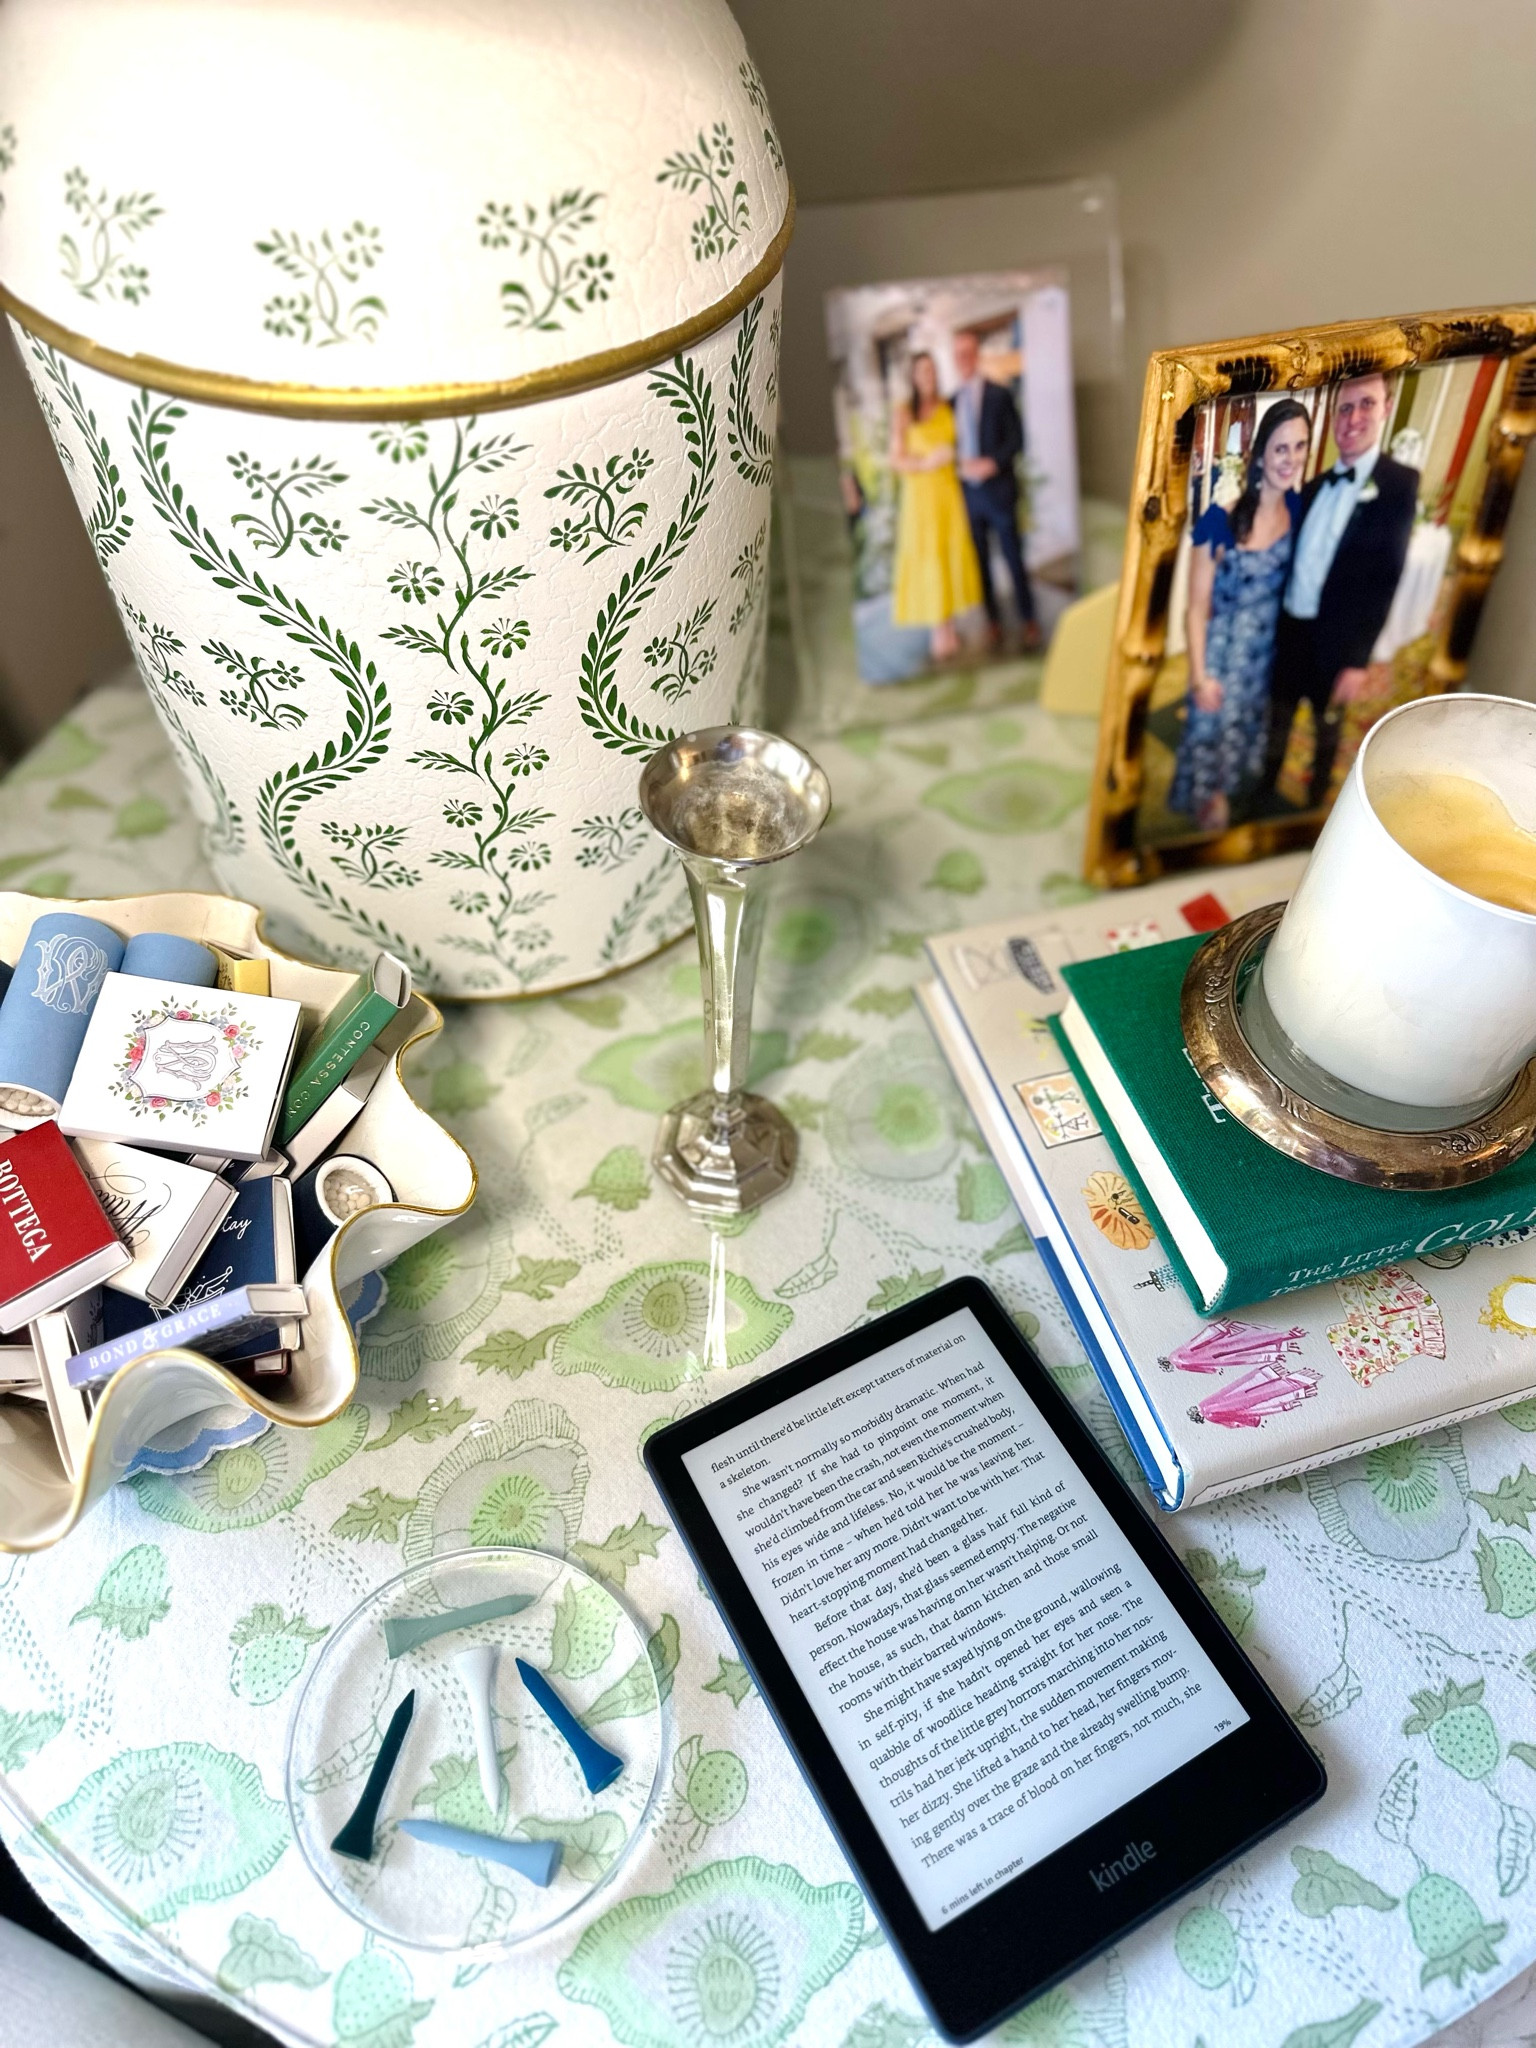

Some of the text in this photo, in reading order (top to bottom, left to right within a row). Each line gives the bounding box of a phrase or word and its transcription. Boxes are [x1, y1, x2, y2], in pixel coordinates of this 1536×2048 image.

[285, 1021, 371, 1119] CONTESSA.COM
[0, 1158, 52, 1263] BOTTEGA
[1288, 1239, 1413, 1283] THE LITTLE
[88, 1303, 223, 1370] BOND & GRACE
[710, 1334, 967, 1474] flesh until there'd be little left except tatters of material on
[719, 1458, 772, 1490] a skeleton.
[736, 1376, 996, 1522] she changed? If she had to pinpoint one moment, it
[741, 1360, 986, 1498] She wasn't normally so morbidly dramatic. When had
[788, 1506, 989, 1625] heart-stopping moment had changed her.
[808, 1498, 1078, 1663] person. Nowadays, that glass seemed empty. The negative
[828, 1528, 1100, 1695] the house, as such, that damn kitchen and those small
[838, 1610, 1007, 1714] rooms with their barred windows.
[857, 1579, 1133, 1752] in self-pity, if she hadn't opened her eyes and seen a
[863, 1562, 1123, 1724] She might have stayed lying on the ground, wallowing
[869, 1596, 1144, 1772] quabble of woodlice heading straight for her nose. The
[879, 1615, 1154, 1789] thoughts of the little grey horrors marching into her nos-
[889, 1630, 1169, 1809] trils had her jerk upright, the sudden movement making
[910, 1666, 1191, 1849] ing gently over the graze and the already swelling bump.
[921, 1683, 1203, 1868] There was a trace of blood on her fingers, not much, she
[1213, 1718, 1233, 1733] 19%
[940, 1856, 1025, 1916] 6 mins left in chapter
[1088, 1841, 1158, 1892] kindle
